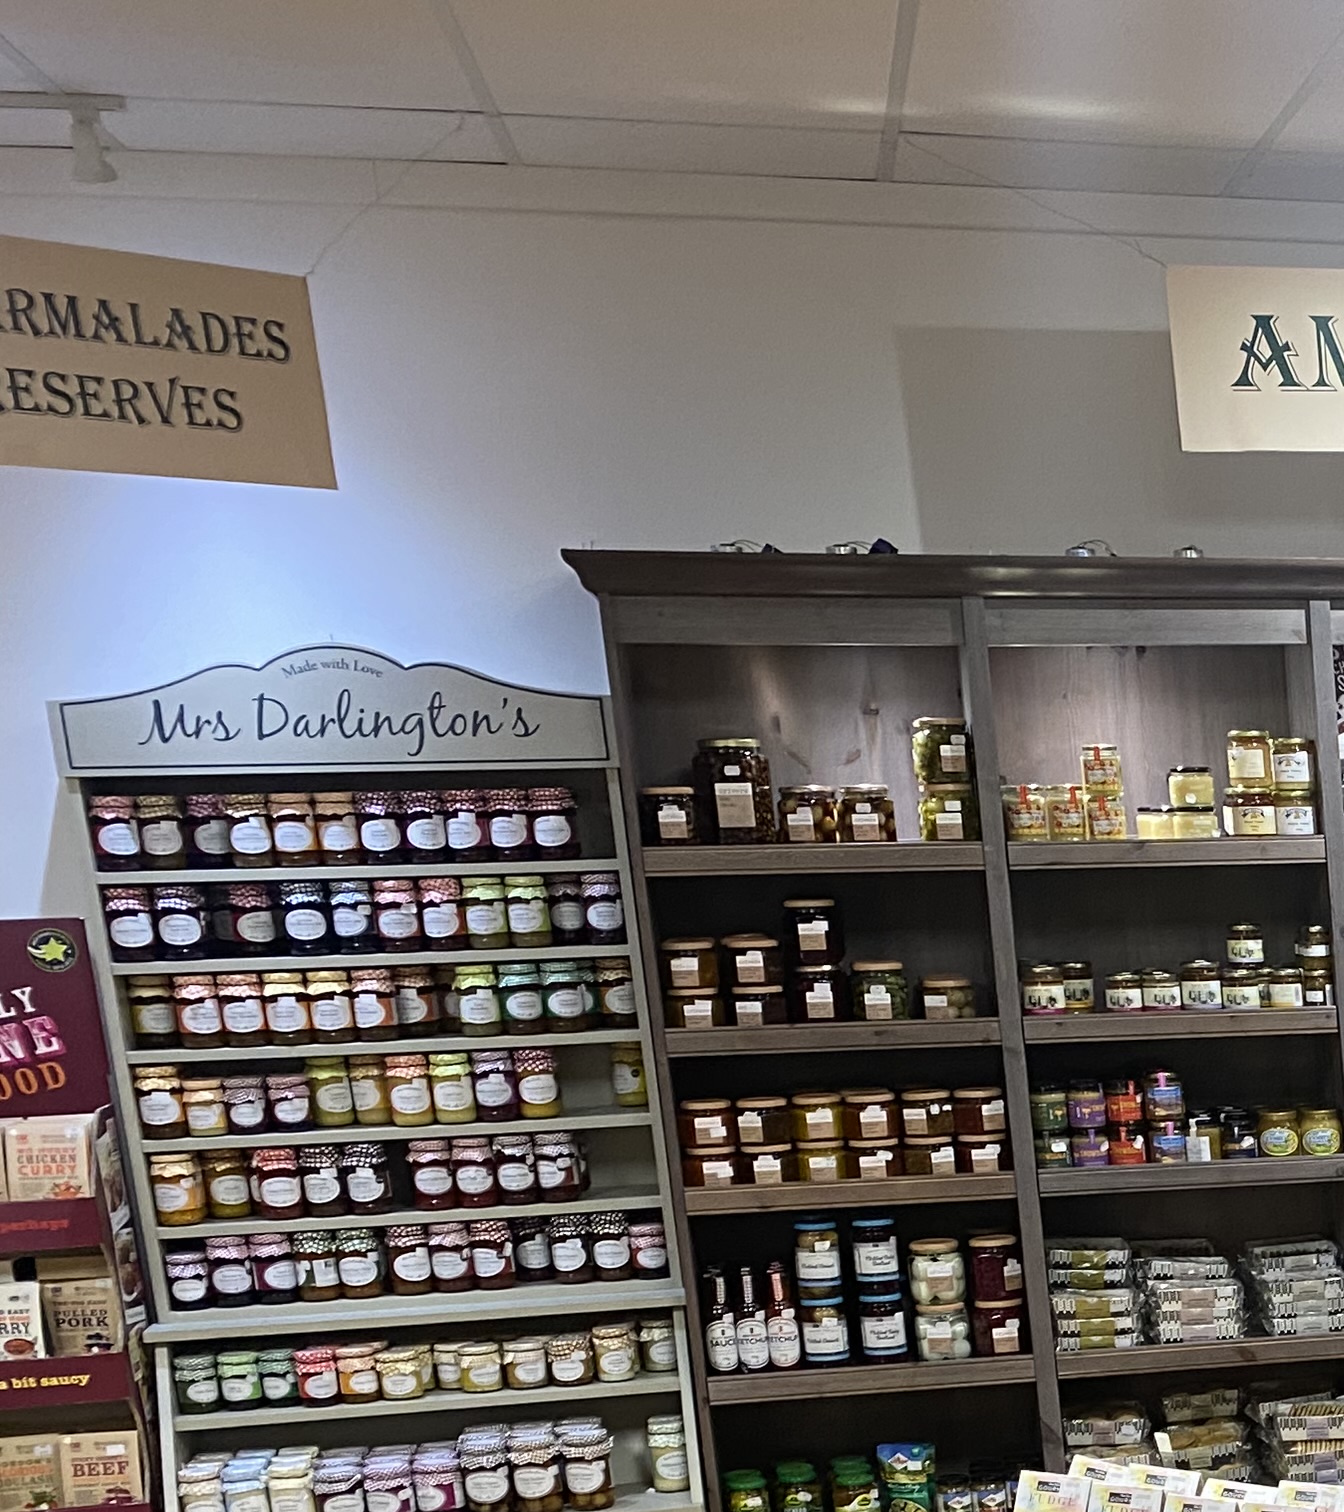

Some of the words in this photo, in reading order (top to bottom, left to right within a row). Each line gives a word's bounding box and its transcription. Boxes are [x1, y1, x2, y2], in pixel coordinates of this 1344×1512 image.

[0, 287, 291, 364] RMALADES
[0, 368, 243, 432] ESERVES
[281, 659, 319, 679] Made
[320, 658, 350, 672] with
[353, 659, 384, 679] Love
[138, 698, 242, 746] Mrs
[252, 688, 541, 757] Darlington's
[18, 1165, 77, 1176] CURRY
[53, 1309, 107, 1318] PULLED
[55, 1316, 109, 1328] PORK
[11, 1376, 37, 1389] bit
[40, 1373, 90, 1388] saucy
[72, 1460, 129, 1478] BEEF
[1029, 1493, 1076, 1507] FUDGE
